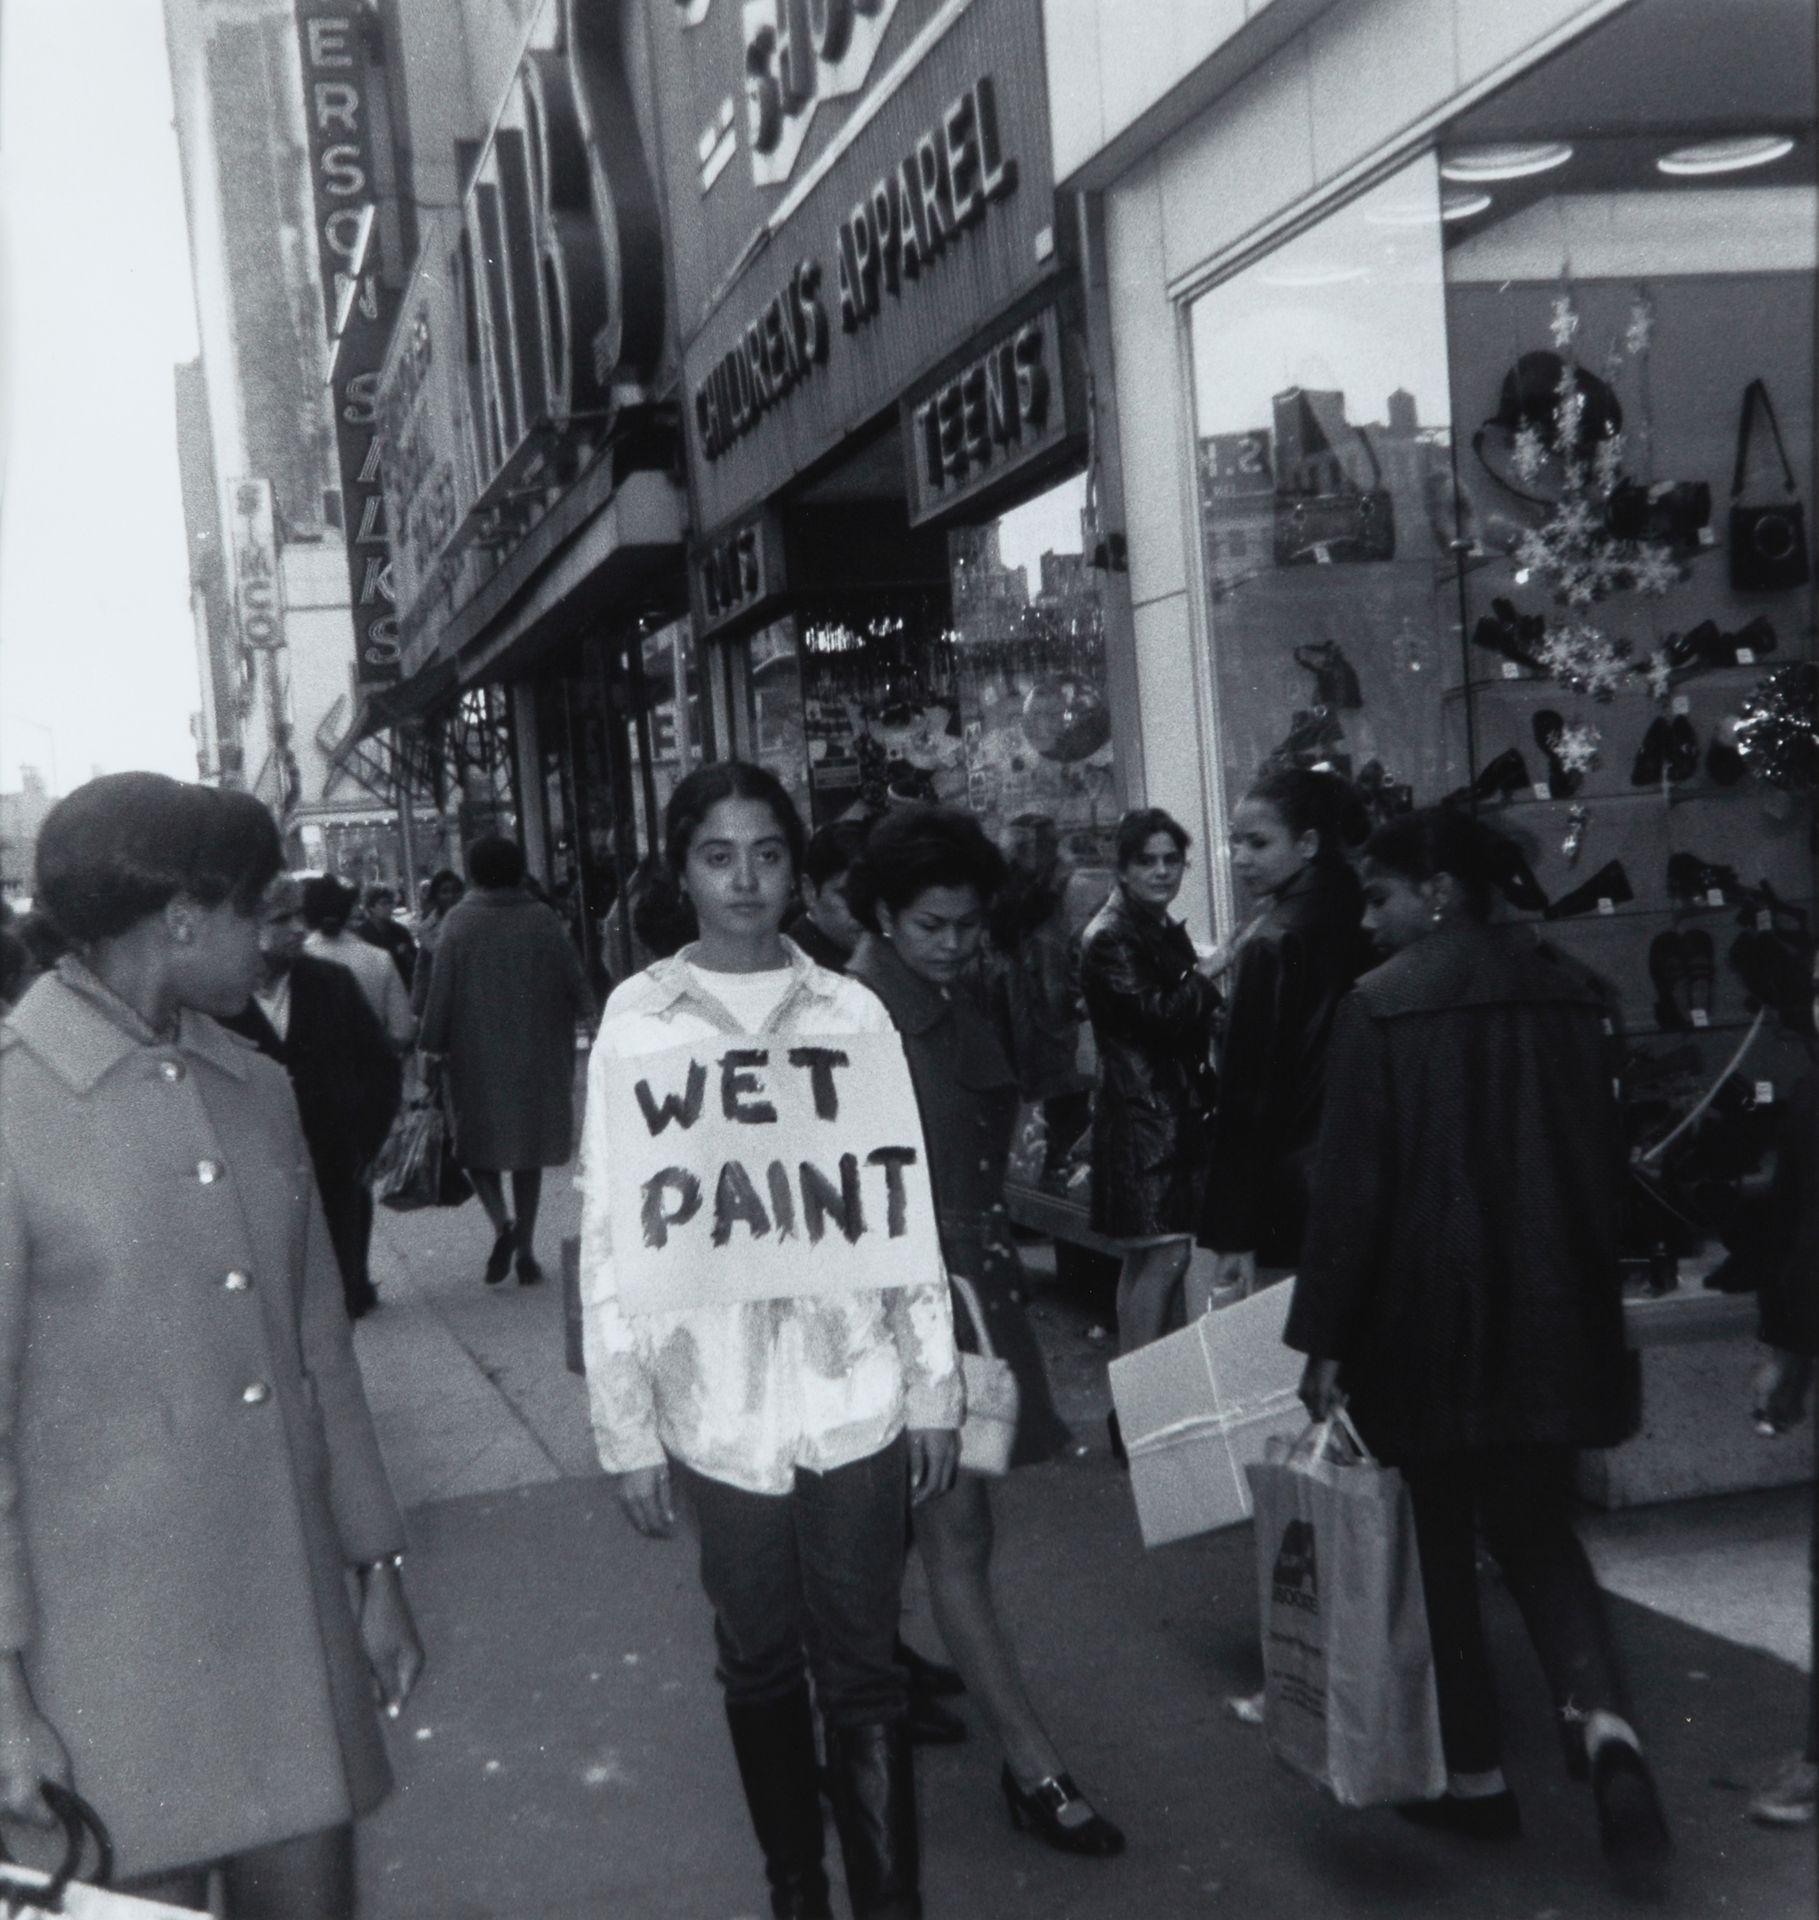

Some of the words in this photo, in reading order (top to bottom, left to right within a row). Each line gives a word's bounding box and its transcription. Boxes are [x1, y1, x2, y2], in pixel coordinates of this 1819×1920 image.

[837, 76, 1017, 331] APPAREL
[634, 1047, 849, 1137] WET
[640, 1146, 917, 1250] PAINT
